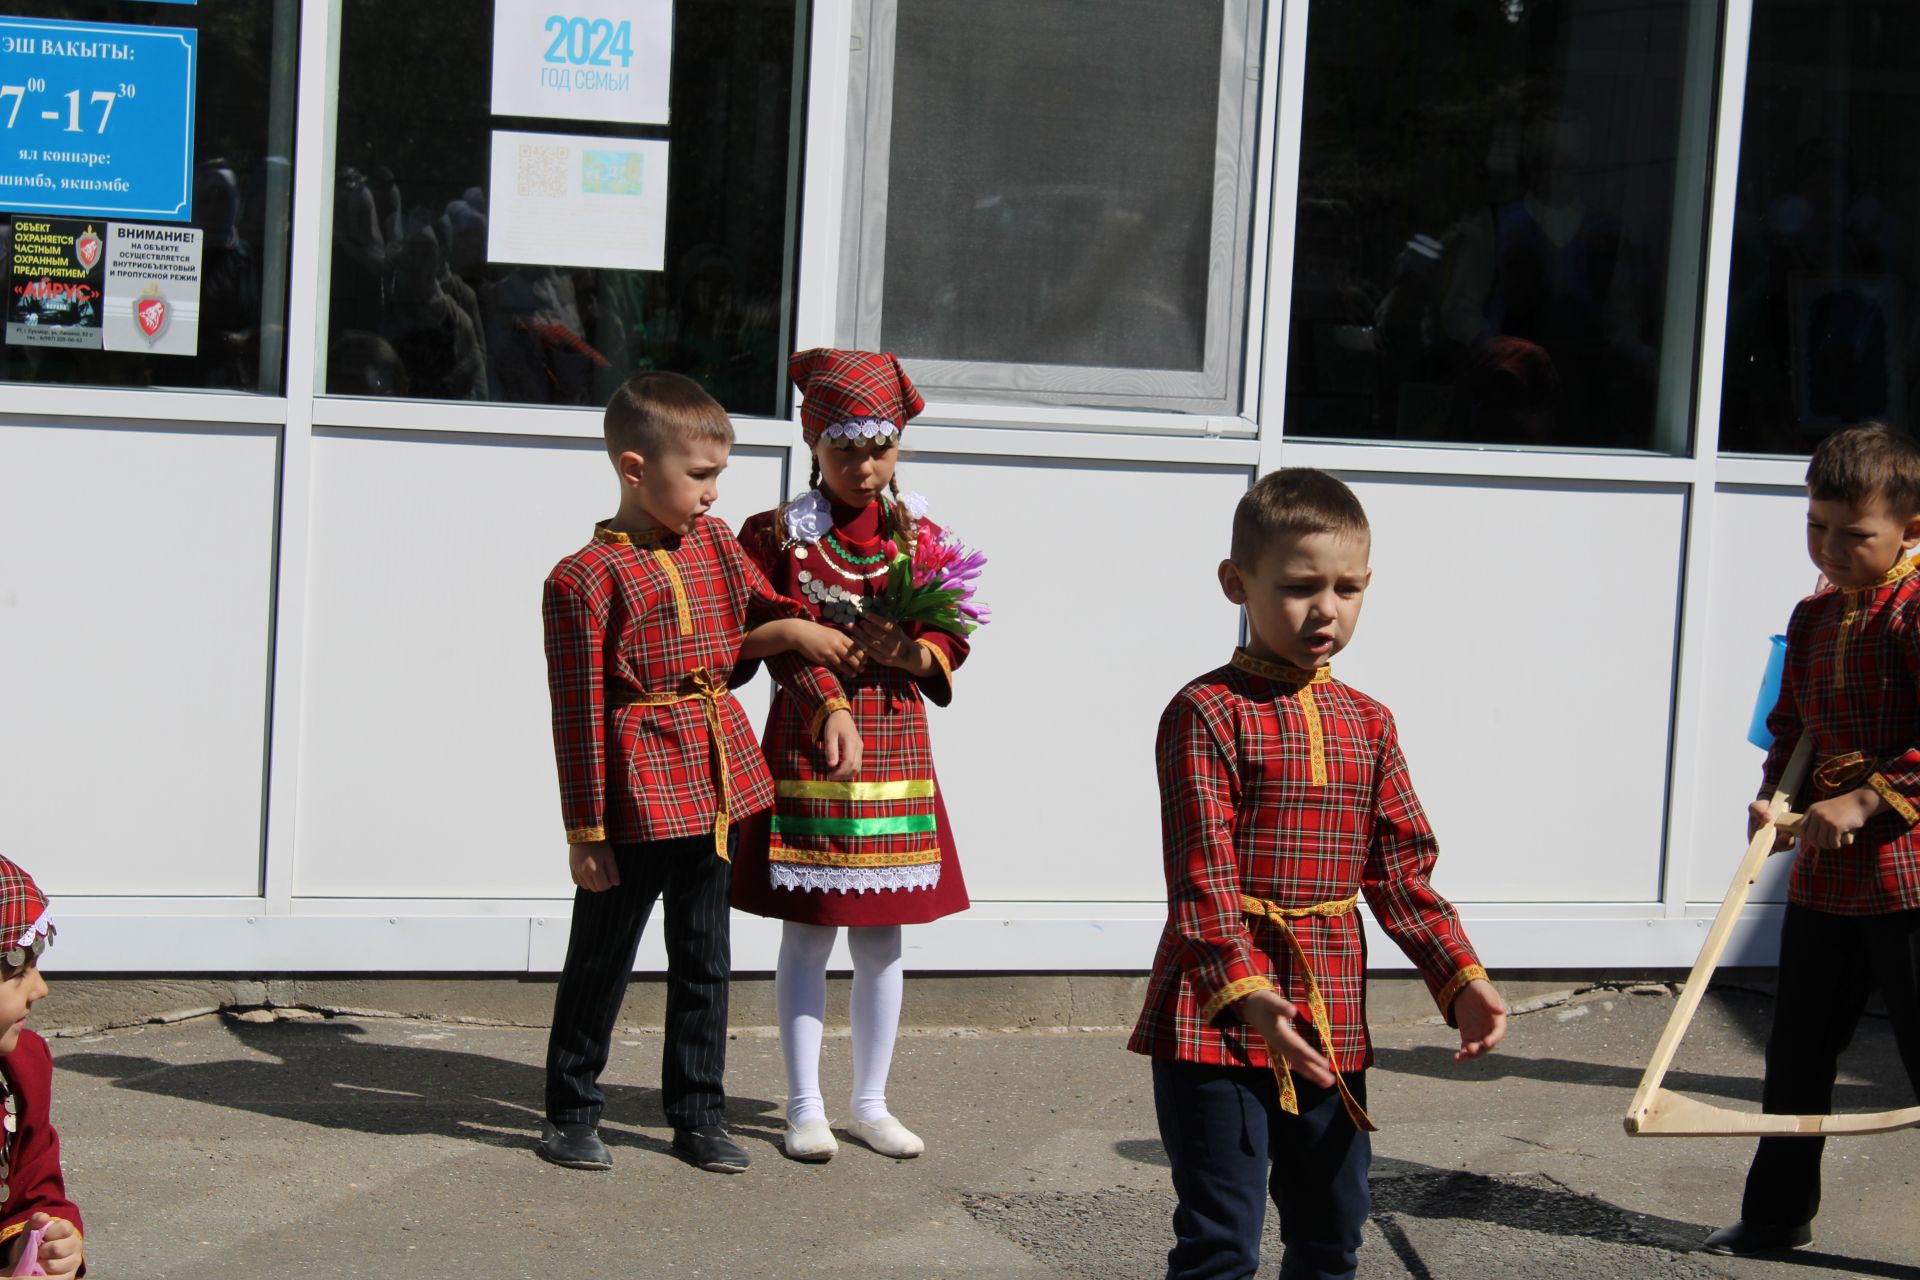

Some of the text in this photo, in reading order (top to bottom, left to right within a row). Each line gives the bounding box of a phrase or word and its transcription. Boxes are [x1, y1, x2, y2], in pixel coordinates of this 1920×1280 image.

[2, 36, 136, 60] ЭШ ВАКЫТЫ:
[544, 15, 634, 68] 2024
[19, 149, 111, 167] ял көннәре:
[60, 178, 130, 192] якшәмбе
[15, 222, 51, 233] ОБЪЕКТ
[14, 233, 74, 245] ОХРАНЯЕТСЯ
[117, 228, 195, 243] ВНИМАНИЕ!
[14, 244, 61, 255] ЧАСТНЫМ
[143, 244, 180, 252] ОБЪЕКТЕ
[13, 255, 69, 266] ОХРАННЫМ
[119, 251, 191, 263] ОСУЩЕСТВЛЯЕТСЯ
[13, 265, 86, 278] ПРЕДПРИЯТИЕМ
[112, 260, 196, 273] ВНУТРИОБЪЕКТОВЫЙ
[117, 270, 168, 280] ПРОПУСКНОЙ
[170, 274, 198, 282] РЕЖИМ
[14, 277, 101, 302] «АЙРУС»
